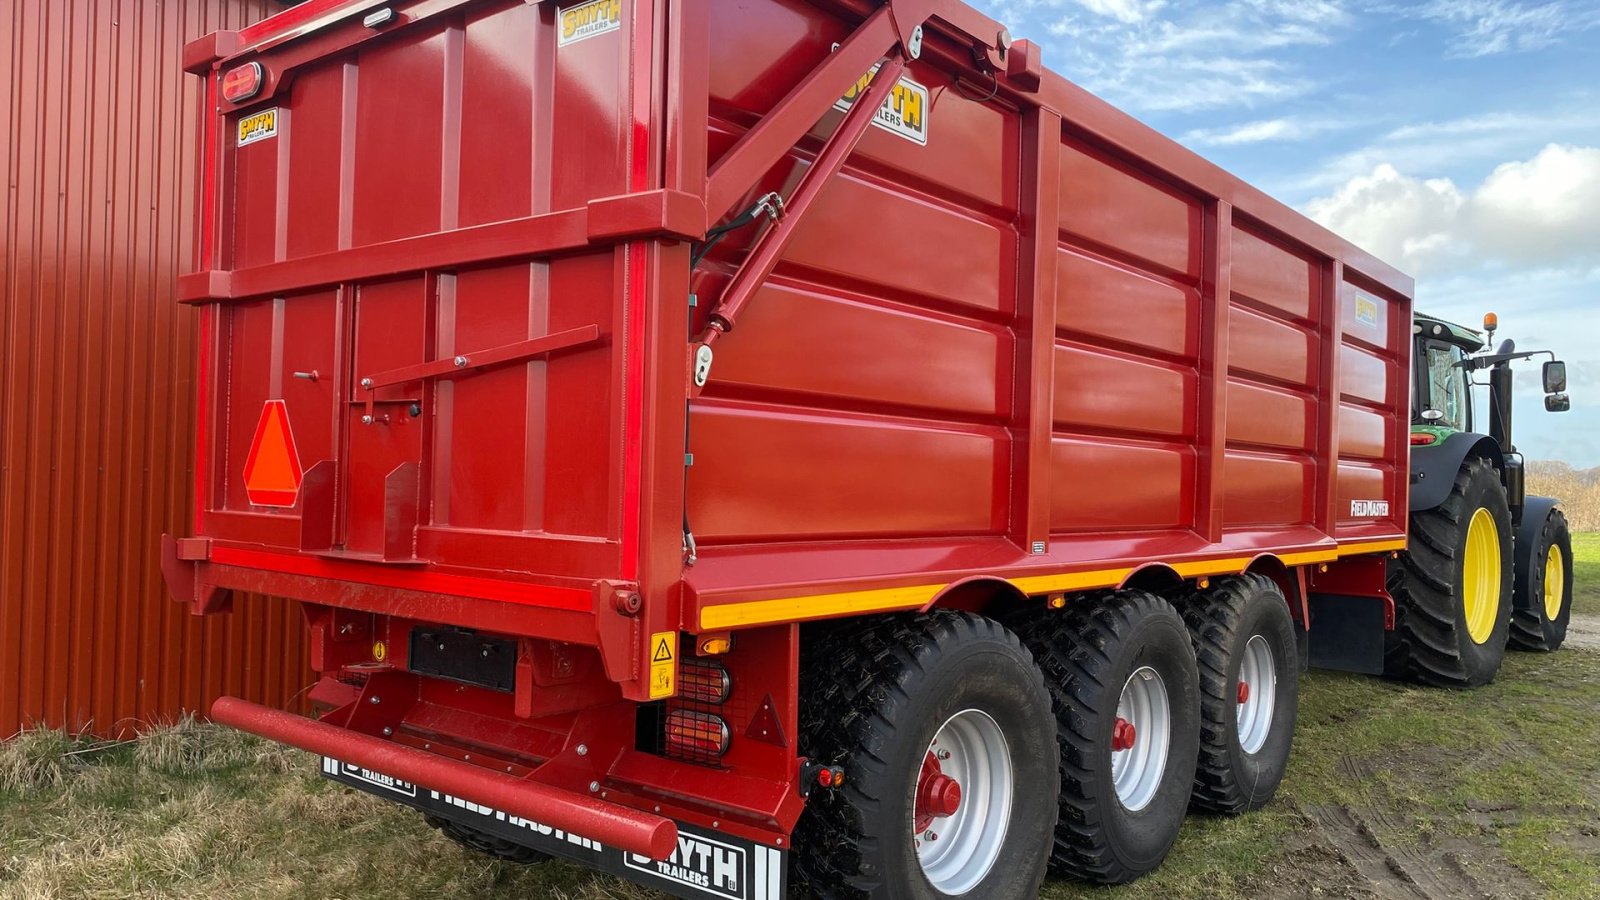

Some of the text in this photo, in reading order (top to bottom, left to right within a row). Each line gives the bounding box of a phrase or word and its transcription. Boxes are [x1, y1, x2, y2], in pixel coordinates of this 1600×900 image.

[563, 0, 621, 39] SMYTH
[577, 20, 608, 36] TRAILERS
[241, 111, 275, 141] SMYTH
[361, 768, 394, 787] TRAILERS
[657, 861, 709, 888] TRAILERS
